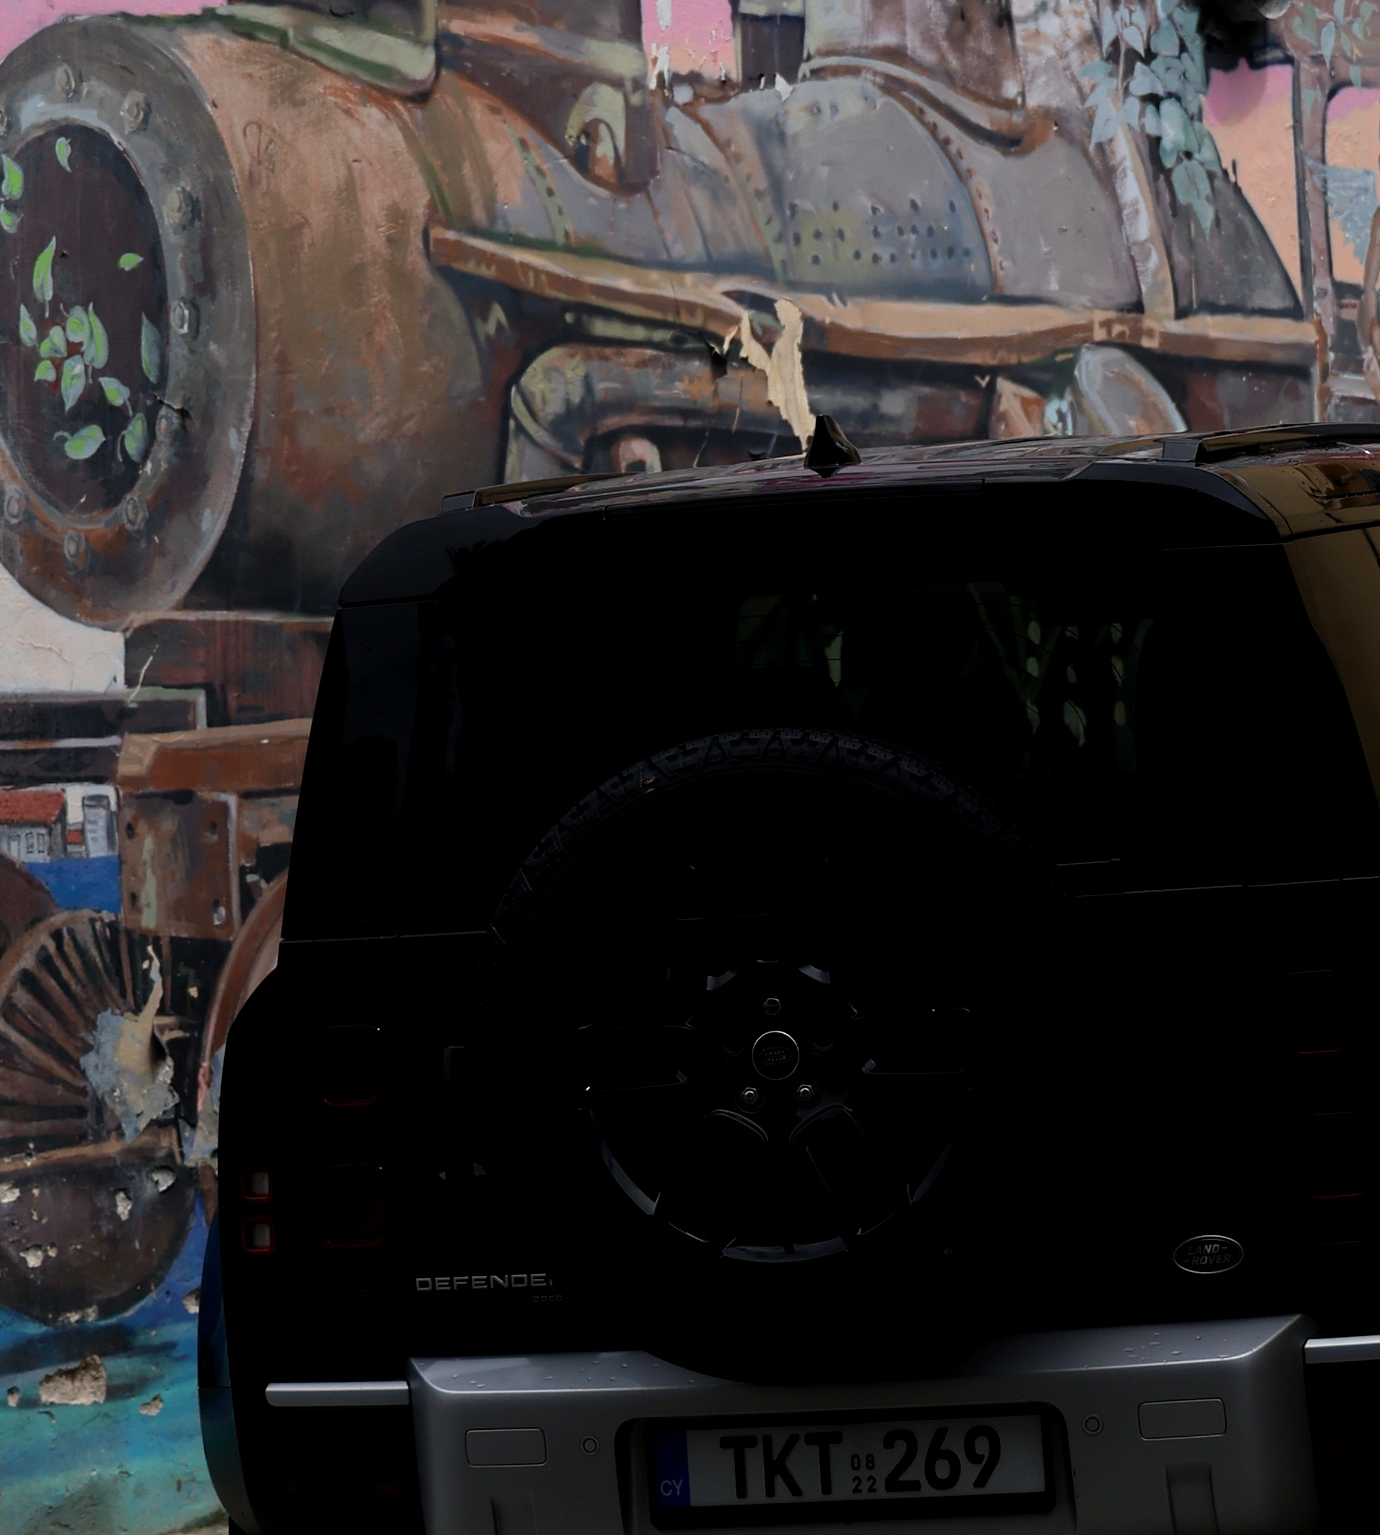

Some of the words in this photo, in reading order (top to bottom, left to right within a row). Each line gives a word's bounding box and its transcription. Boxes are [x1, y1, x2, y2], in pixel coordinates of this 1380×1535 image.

[415, 1273, 554, 1292] DEFENDE
[719, 1431, 843, 1499] TKT
[882, 1425, 1002, 1493] 269
[850, 1453, 876, 1471] 08
[660, 1478, 684, 1497] CY
[851, 1476, 877, 1494] 22
